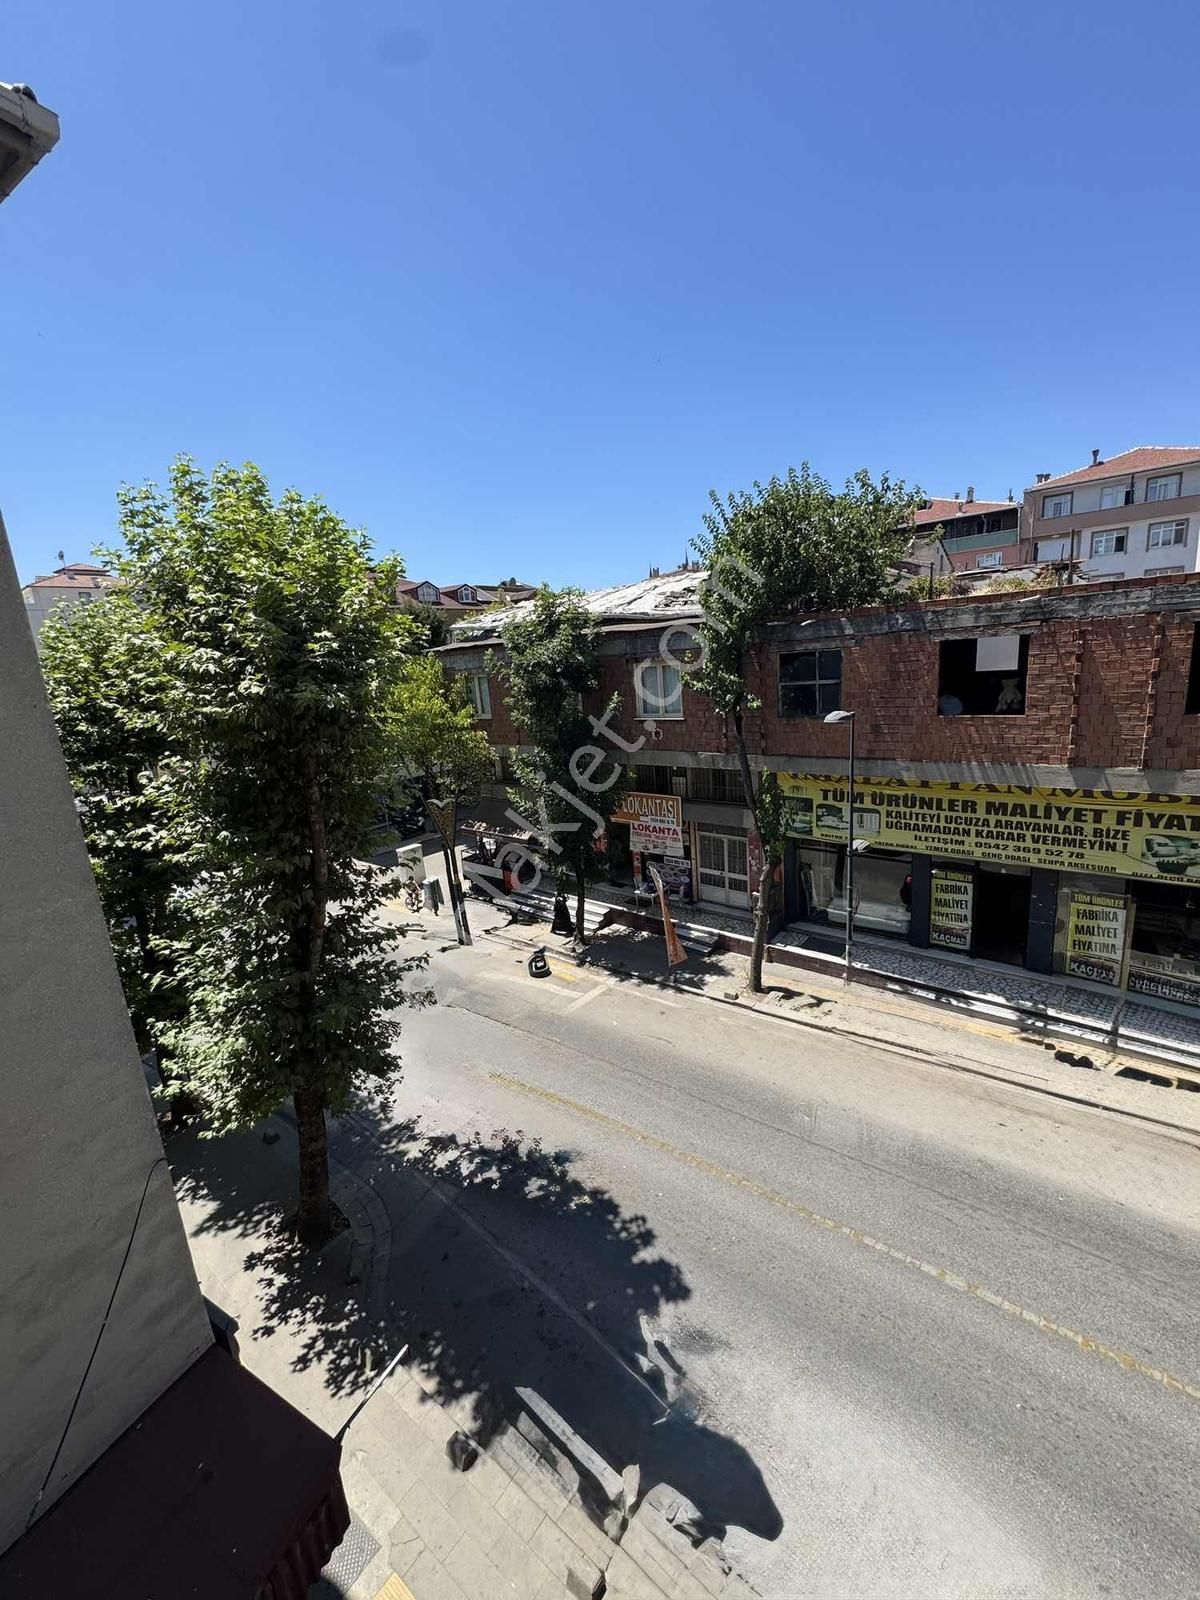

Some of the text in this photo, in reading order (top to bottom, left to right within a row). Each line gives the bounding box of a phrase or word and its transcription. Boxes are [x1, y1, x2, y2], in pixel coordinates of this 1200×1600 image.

[622, 796, 678, 818] LOKANTASI
[820, 788, 865, 805] TÜM
[871, 790, 977, 815] ÜRÜNLER
[985, 800, 1108, 824] MALİYET
[631, 822, 679, 837] LOKANTA
[885, 809, 941, 823] KALİTEYİ
[944, 815, 991, 829] UCUZA
[1093, 826, 1131, 841] BİZE
[885, 820, 971, 838] UĞRAMADAN
[974, 828, 1027, 843] KARAR
[1030, 833, 1117, 852] VERMEYİN
[914, 834, 966, 847] İLETİŞİM
[974, 841, 1010, 851] 0542
[1012, 844, 1041, 855] 369
[1044, 849, 1064, 858] 52
[1066, 851, 1086, 860] 78
[935, 883, 969, 895] FABRİKA
[934, 897, 968, 910] MALİYET
[1076, 908, 1118, 922] FABRİKA
[1074, 924, 1118, 939] MALİYET
[1072, 938, 1117, 955] FİYATINA
